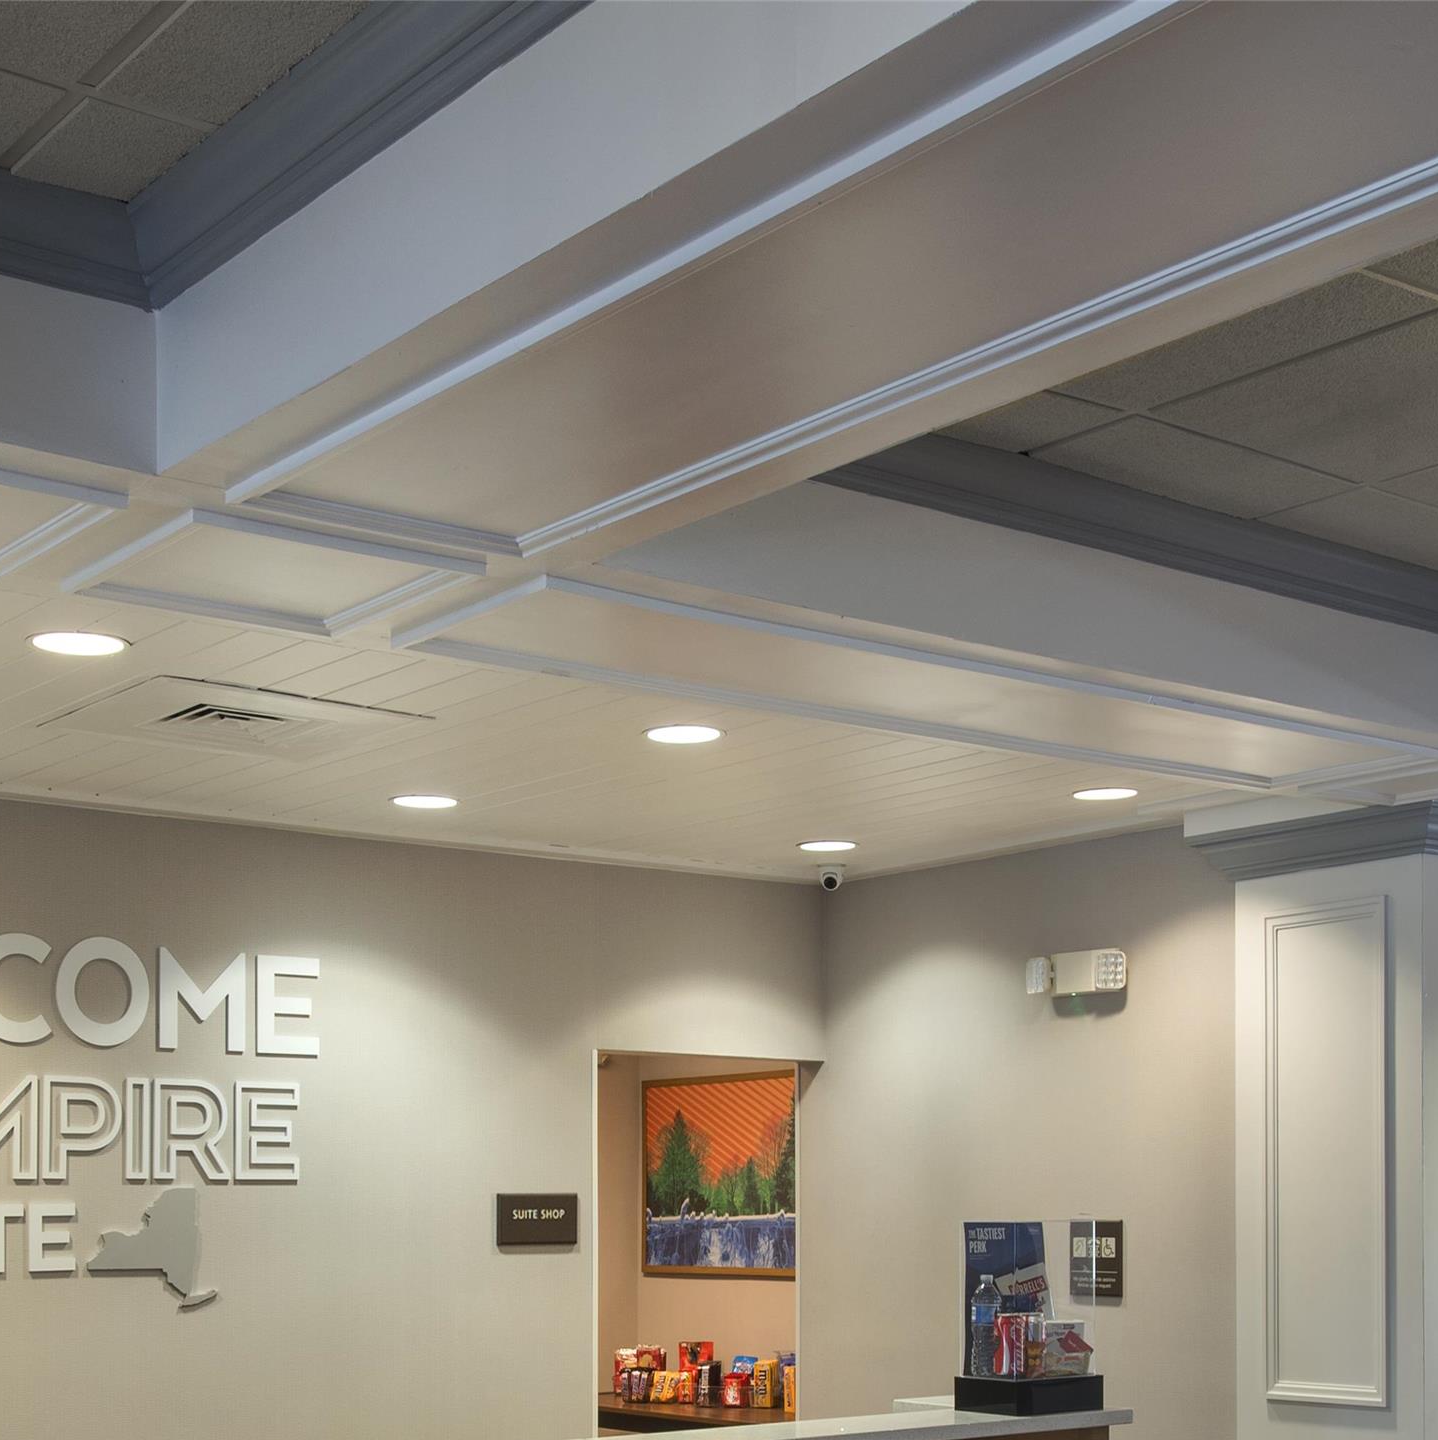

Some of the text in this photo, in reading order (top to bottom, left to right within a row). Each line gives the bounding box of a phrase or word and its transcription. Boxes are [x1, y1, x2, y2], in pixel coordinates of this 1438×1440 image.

[512, 1209, 565, 1219] SUITE SHOP
[976, 1227, 1006, 1241] TASTIEST
[969, 1240, 987, 1254] PERK
